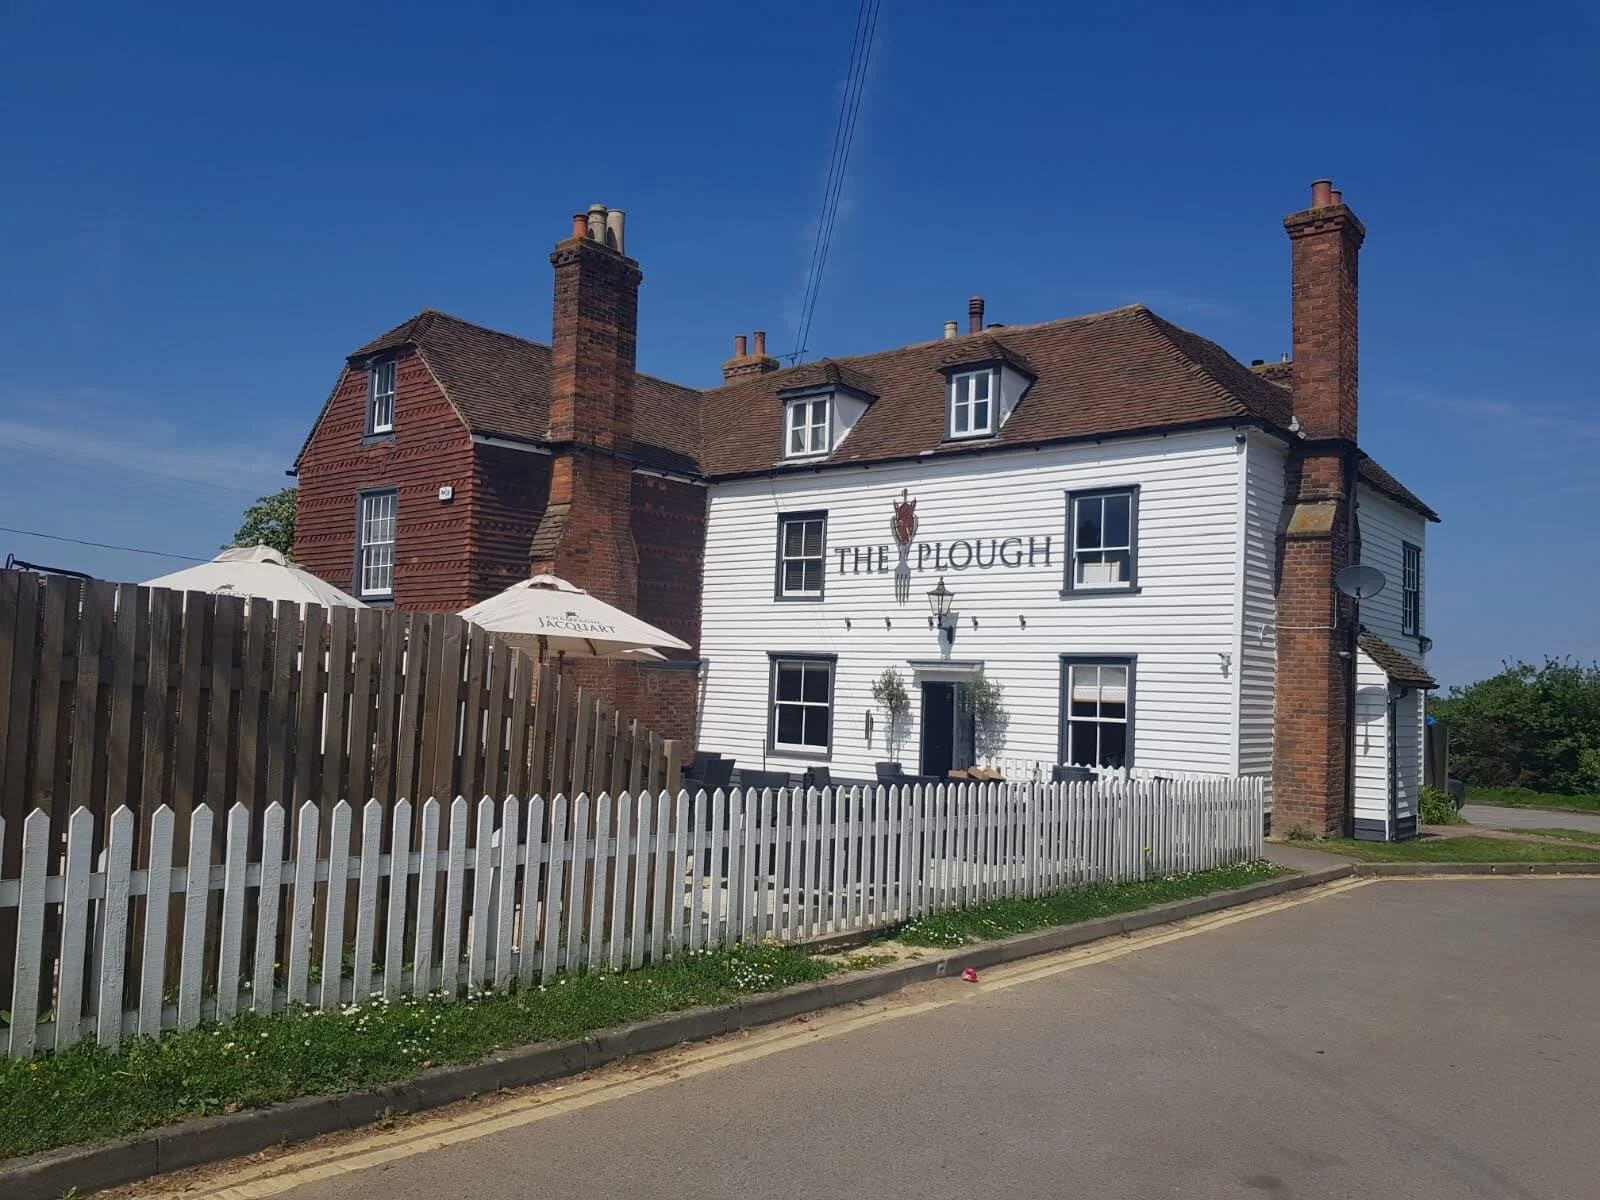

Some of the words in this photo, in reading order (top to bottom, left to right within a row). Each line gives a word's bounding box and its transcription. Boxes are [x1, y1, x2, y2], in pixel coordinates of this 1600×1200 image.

[834, 545, 889, 575] THE
[917, 536, 1053, 573] PLOUGH
[538, 617, 616, 633] JACQUART
